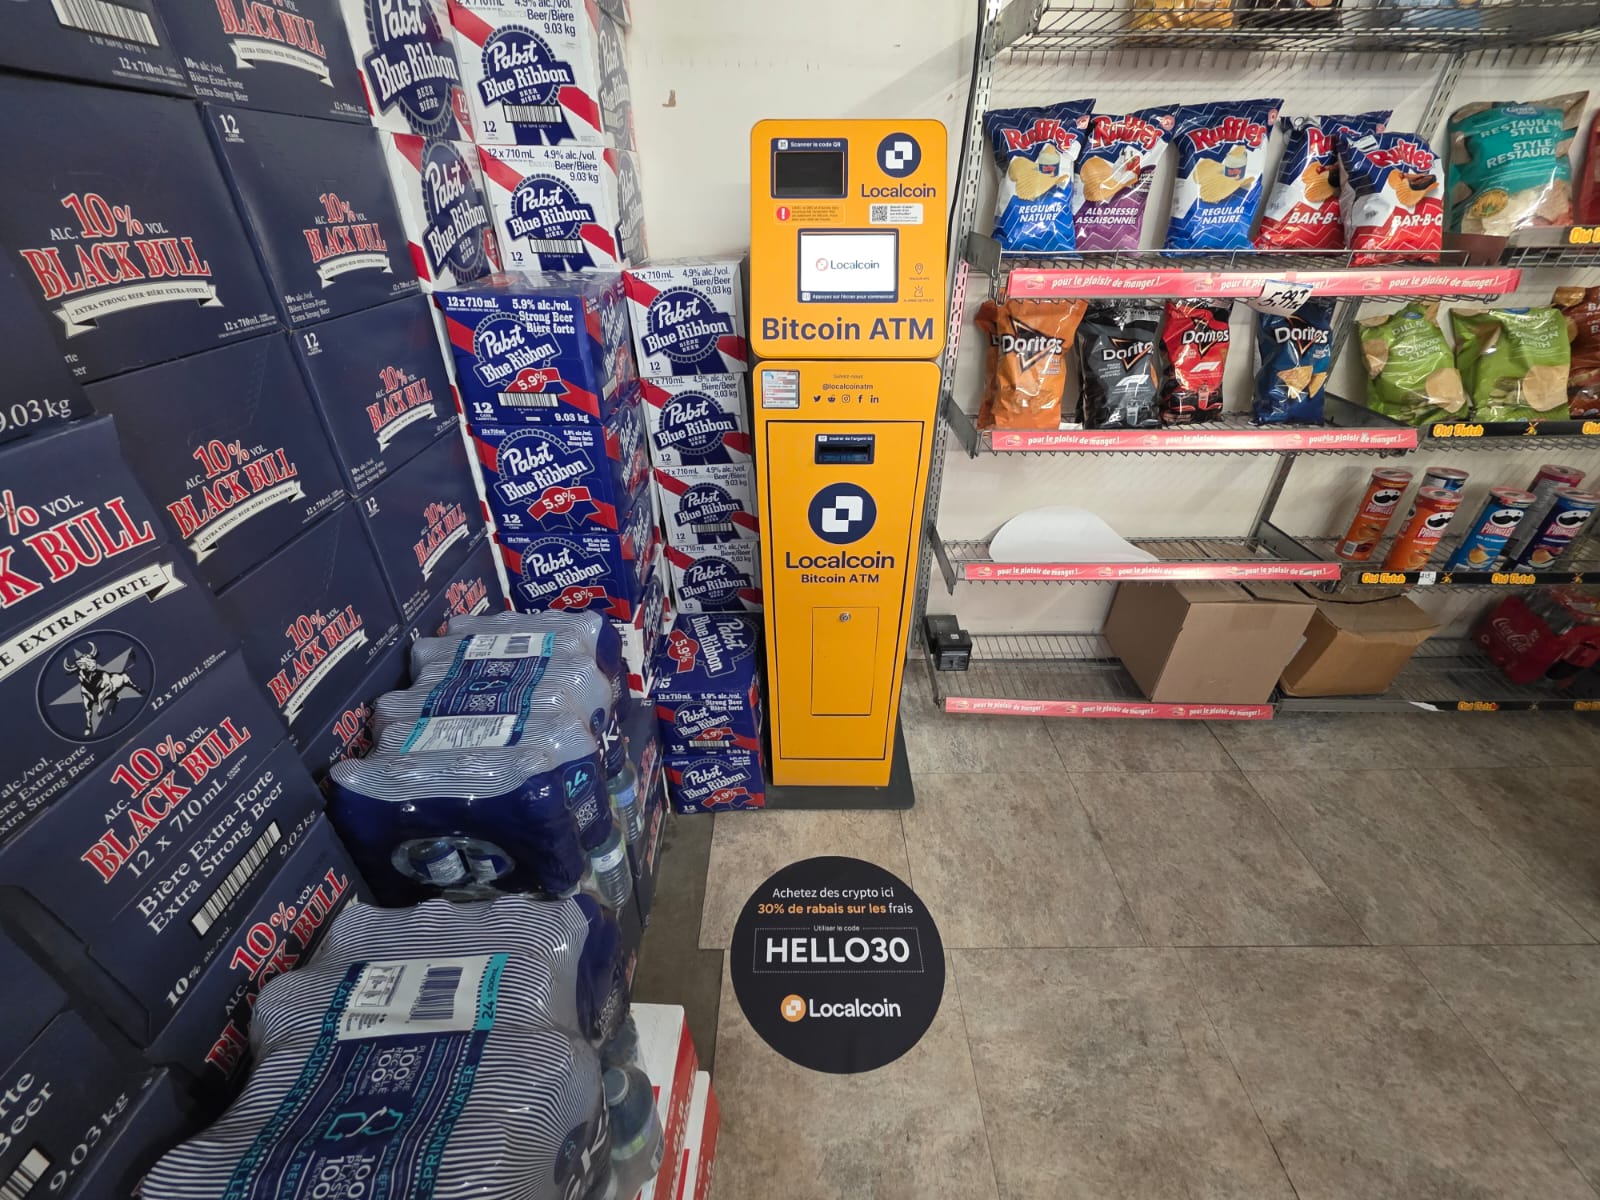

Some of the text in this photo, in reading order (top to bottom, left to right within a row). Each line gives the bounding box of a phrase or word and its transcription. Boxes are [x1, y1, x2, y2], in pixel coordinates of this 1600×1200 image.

[527, 9, 574, 22] Beer/Bière
[278, 10, 326, 59] BULL
[544, 23, 562, 35] 9.03
[487, 41, 539, 72] Pabst
[371, 52, 413, 102] Blue
[404, 42, 458, 83] Ribbon
[482, 62, 570, 103] Blue Ribbon
[218, 114, 240, 135] 12
[483, 120, 497, 133] 12
[1000, 118, 1077, 153] Ruffles
[1091, 114, 1164, 150] Ruffles
[1186, 116, 1267, 153] Ruffles
[1510, 126, 1550, 137] STYLE
[1366, 140, 1436, 171] Ruffles
[1512, 138, 1552, 151] STYLE
[555, 161, 598, 172] Beer/Bière
[425, 160, 465, 206] Pabst
[861, 183, 936, 198] Localcoin
[319, 193, 356, 223] 10%
[517, 187, 563, 212] Pabst
[1019, 202, 1063, 214] REGULAR
[1202, 205, 1244, 217] REGULAR
[50, 193, 144, 241] ALC. 10%
[510, 205, 591, 237] Blue Ribbon
[1020, 212, 1059, 223] NATURE
[1202, 213, 1241, 225] NATURE
[303, 223, 388, 263] BLACK BULL
[512, 251, 524, 262] 12
[830, 259, 880, 270] Localcoin
[19, 237, 212, 301] BLACK BULL
[1052, 275, 1154, 291] pour le plaisir de manger
[1220, 279, 1240, 291] pour
[1242, 278, 1251, 288] le
[1389, 275, 1493, 290] pour le plaisir de manger
[512, 299, 572, 311] 5.9% alc./vol.
[518, 311, 574, 323] Strong Beer
[653, 297, 701, 328] Pabst
[553, 323, 575, 334] forte
[646, 320, 729, 353] Blue Ribbon
[762, 316, 934, 340] Bitcoin ATM
[1182, 330, 1229, 344] Doritos
[1274, 327, 1329, 344] Doritos
[304, 332, 319, 349] 12
[478, 324, 525, 359] Pabst
[1002, 335, 1064, 354] Doritos
[480, 343, 555, 383] Blue Ribbon
[649, 361, 660, 370] 12
[822, 383, 874, 391] @localcoinatm
[44, 398, 72, 418] kg
[366, 378, 433, 433] BLACK BULL
[473, 402, 494, 413] 12
[554, 413, 575, 422] 9.03
[666, 400, 709, 426] Pabst
[657, 418, 734, 447] Blue Ribbon
[1028, 437, 1045, 445] pour
[1053, 435, 1078, 444] plaisir
[1079, 436, 1089, 444] de
[1089, 437, 1116, 446] manger
[1433, 424, 1484, 437] Old Dutch
[193, 440, 250, 479] 10%
[502, 441, 554, 476] Pabst
[501, 460, 588, 501] Blue Ribbon
[167, 447, 298, 540] BLACK BULL
[684, 490, 720, 507] Pabst
[502, 514, 521, 523] 12
[678, 502, 740, 523] Blue Ribbon
[22, 496, 156, 583] BULL
[526, 547, 574, 577] Pabst
[785, 551, 895, 569] Localcoin
[523, 563, 604, 598] Blue Ribbon
[689, 564, 727, 583] Pabst
[801, 573, 880, 584] Bitcoin ATM
[682, 578, 747, 598] Blue Ribbon
[18, 574, 151, 655] EXTRA-FORTE
[285, 609, 327, 651] 10%
[267, 636, 327, 709] BLACK
[321, 604, 363, 650] BULL
[678, 707, 709, 724] Pabst
[18, 745, 87, 801] Extra-Forte
[111, 734, 188, 799] 10%
[686, 765, 722, 786] Pabst
[27, 753, 95, 811] Strong Beer
[80, 716, 252, 884] BLACK BULL
[136, 862, 191, 919] Bière
[189, 770, 274, 863] Extra-Forte
[127, 850, 155, 879] 12
[156, 836, 172, 852] x
[147, 878, 201, 935] Extra
[200, 819, 253, 878] Strong
[250, 780, 284, 821] Beer
[772, 887, 894, 900] Achetez des crypto ici
[289, 866, 350, 949] BULL
[757, 902, 914, 914] 30% de rabais sur les frais
[229, 902, 297, 982] 10%
[766, 937, 910, 963] HELLO30
[336, 981, 352, 1013] EAU
[809, 998, 902, 1018] Localcoin
[482, 1001, 494, 1020] 24
[323, 1012, 338, 1034] DE
[289, 1036, 328, 1097] SOURCE
[421, 1064, 476, 1190] SPRING WATER
